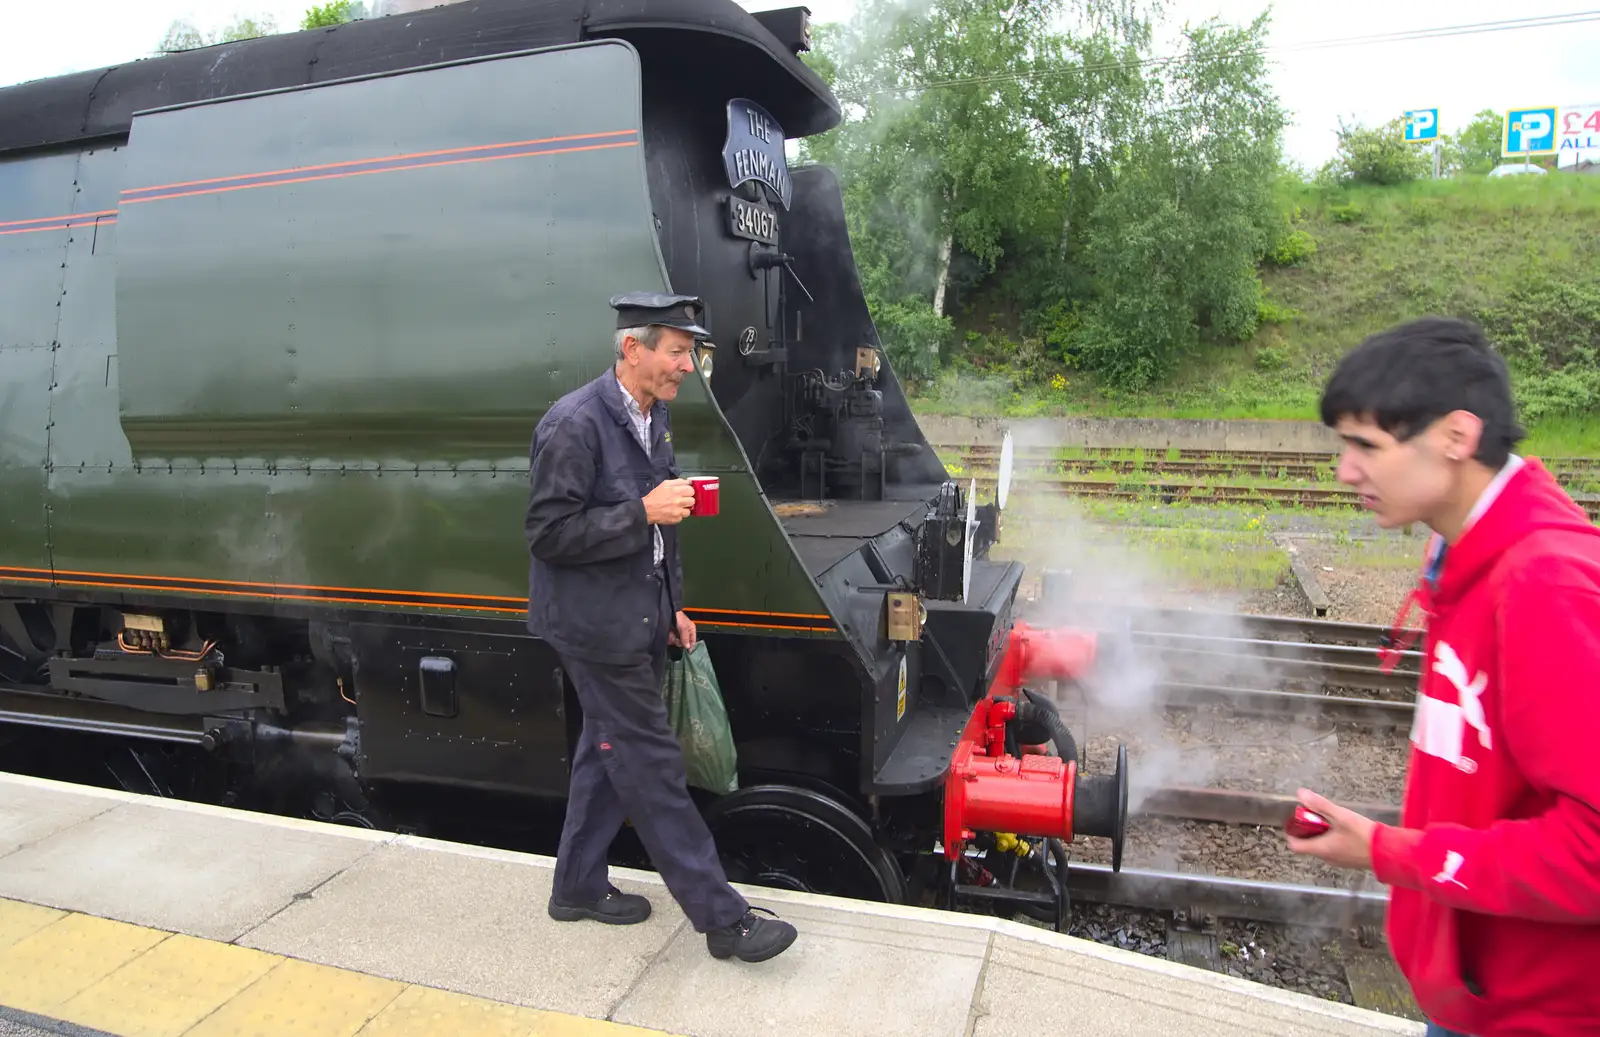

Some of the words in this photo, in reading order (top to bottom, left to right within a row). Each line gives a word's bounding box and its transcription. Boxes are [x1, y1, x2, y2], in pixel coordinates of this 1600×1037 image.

[746, 107, 770, 144] THE
[1560, 136, 1599, 150] ALL
[735, 148, 786, 198] FENMAN
[737, 203, 775, 239] 34067
